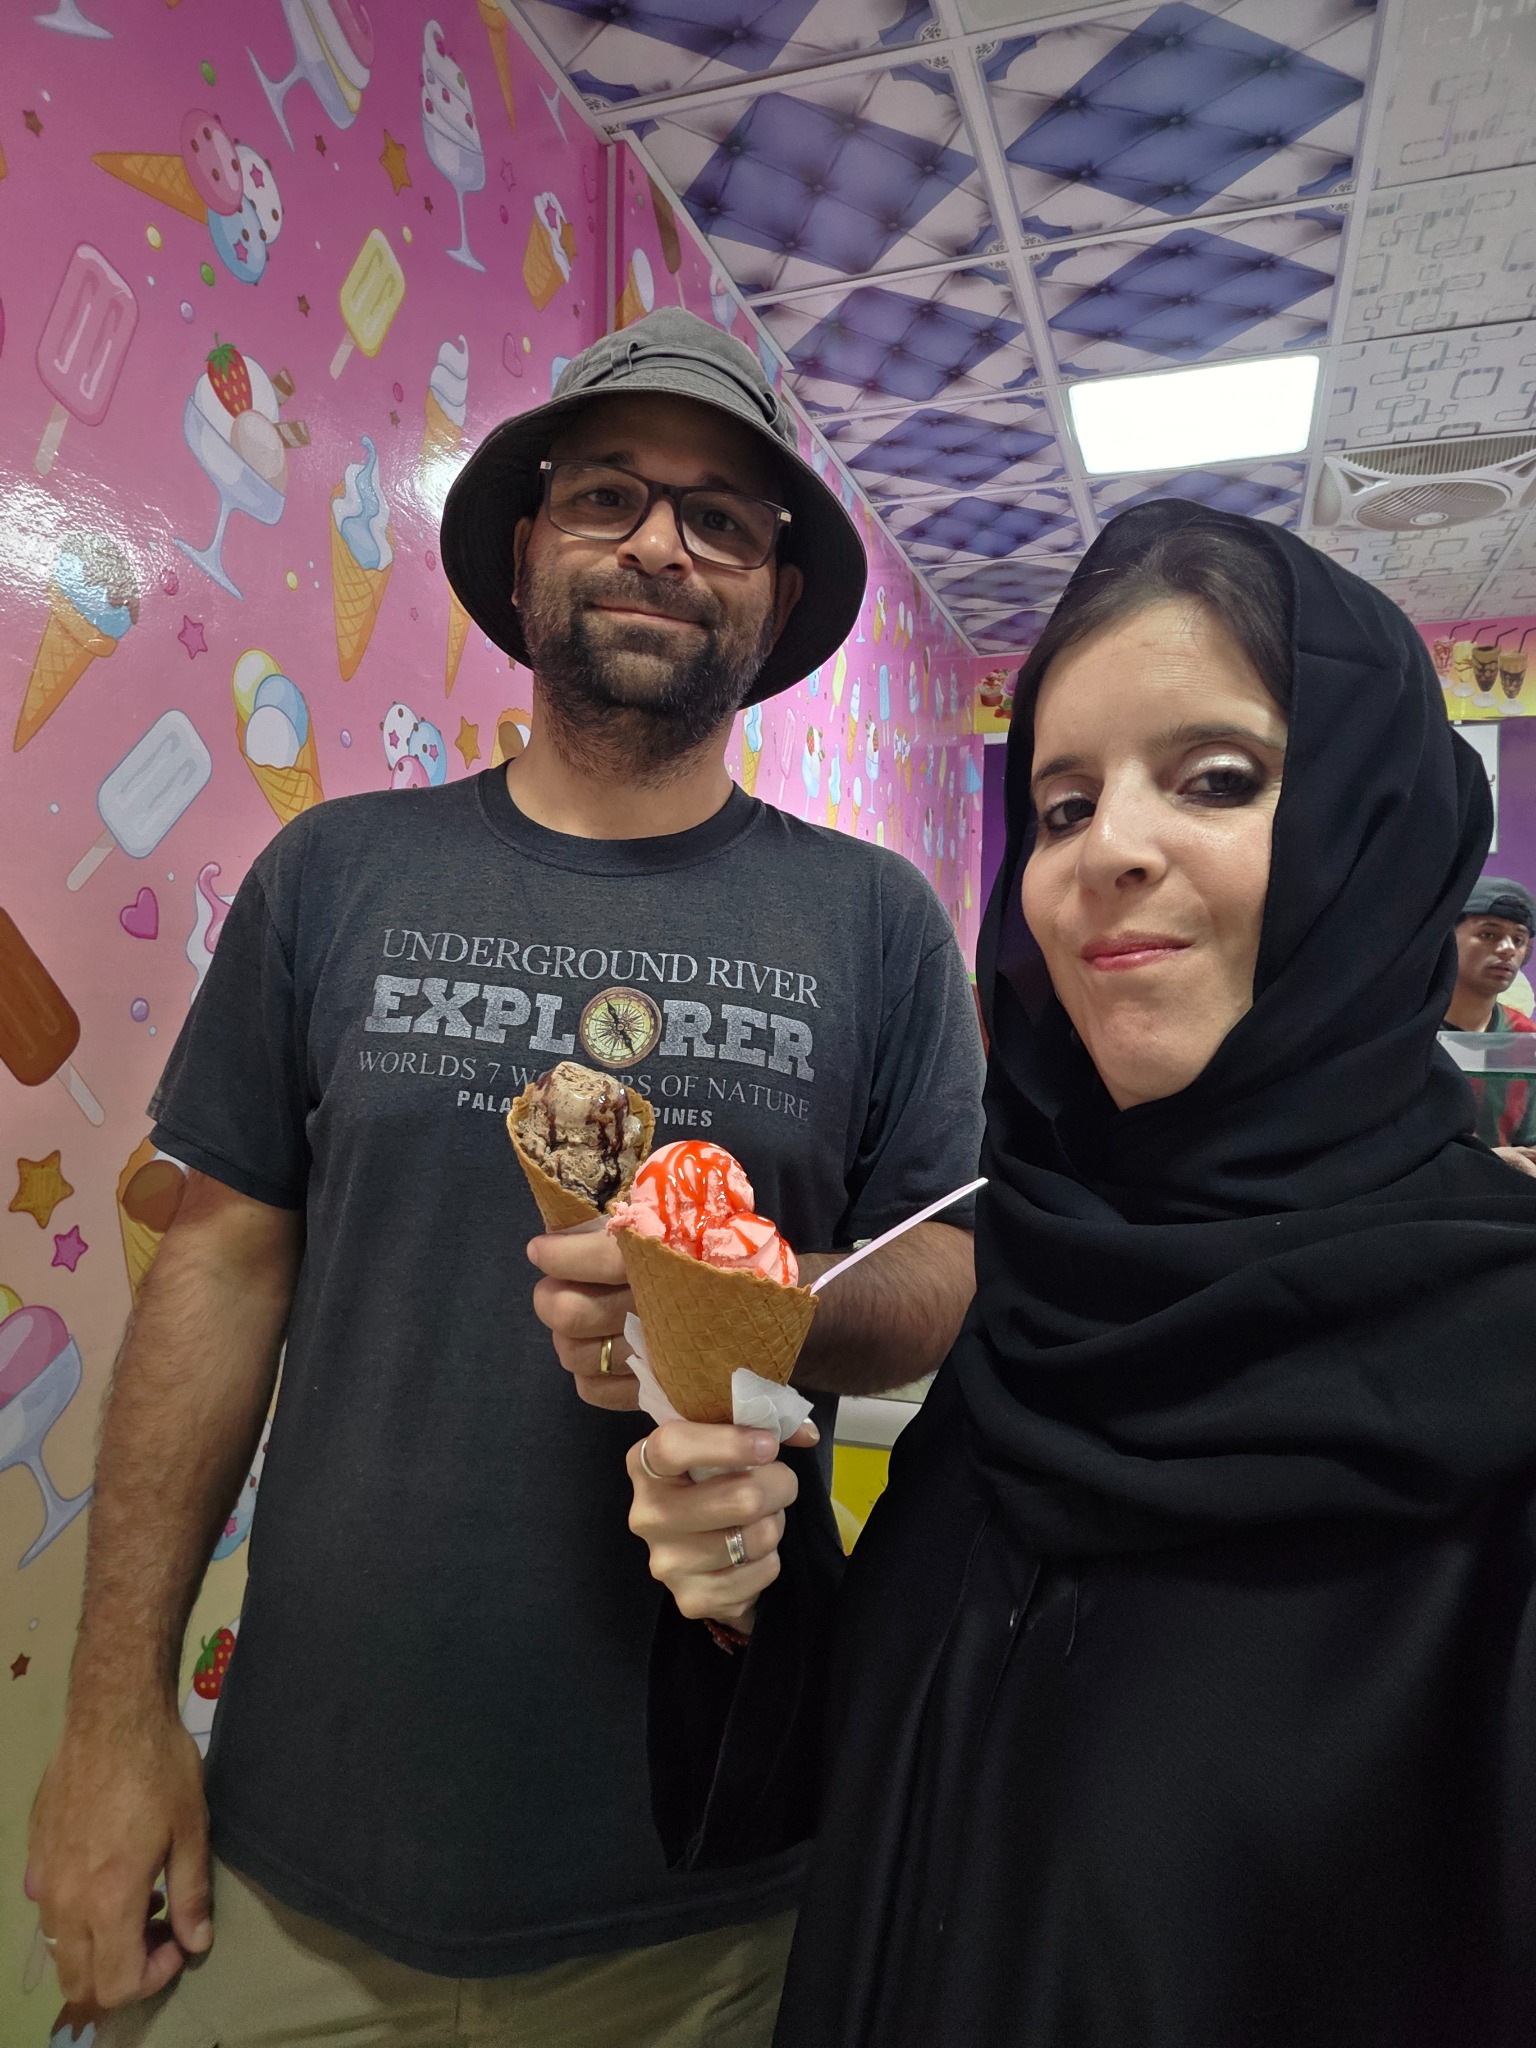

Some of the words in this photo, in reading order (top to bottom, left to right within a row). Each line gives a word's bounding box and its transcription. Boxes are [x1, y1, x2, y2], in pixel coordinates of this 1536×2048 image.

[382, 928, 698, 983] UNDERGROUND
[706, 956, 821, 1008] RIVER
[358, 1051, 477, 1080] WORLDS
[487, 1062, 501, 1083] 7
[661, 1075, 699, 1097] OF
[707, 1077, 810, 1121] NATURE
[457, 1090, 511, 1113] PALA
